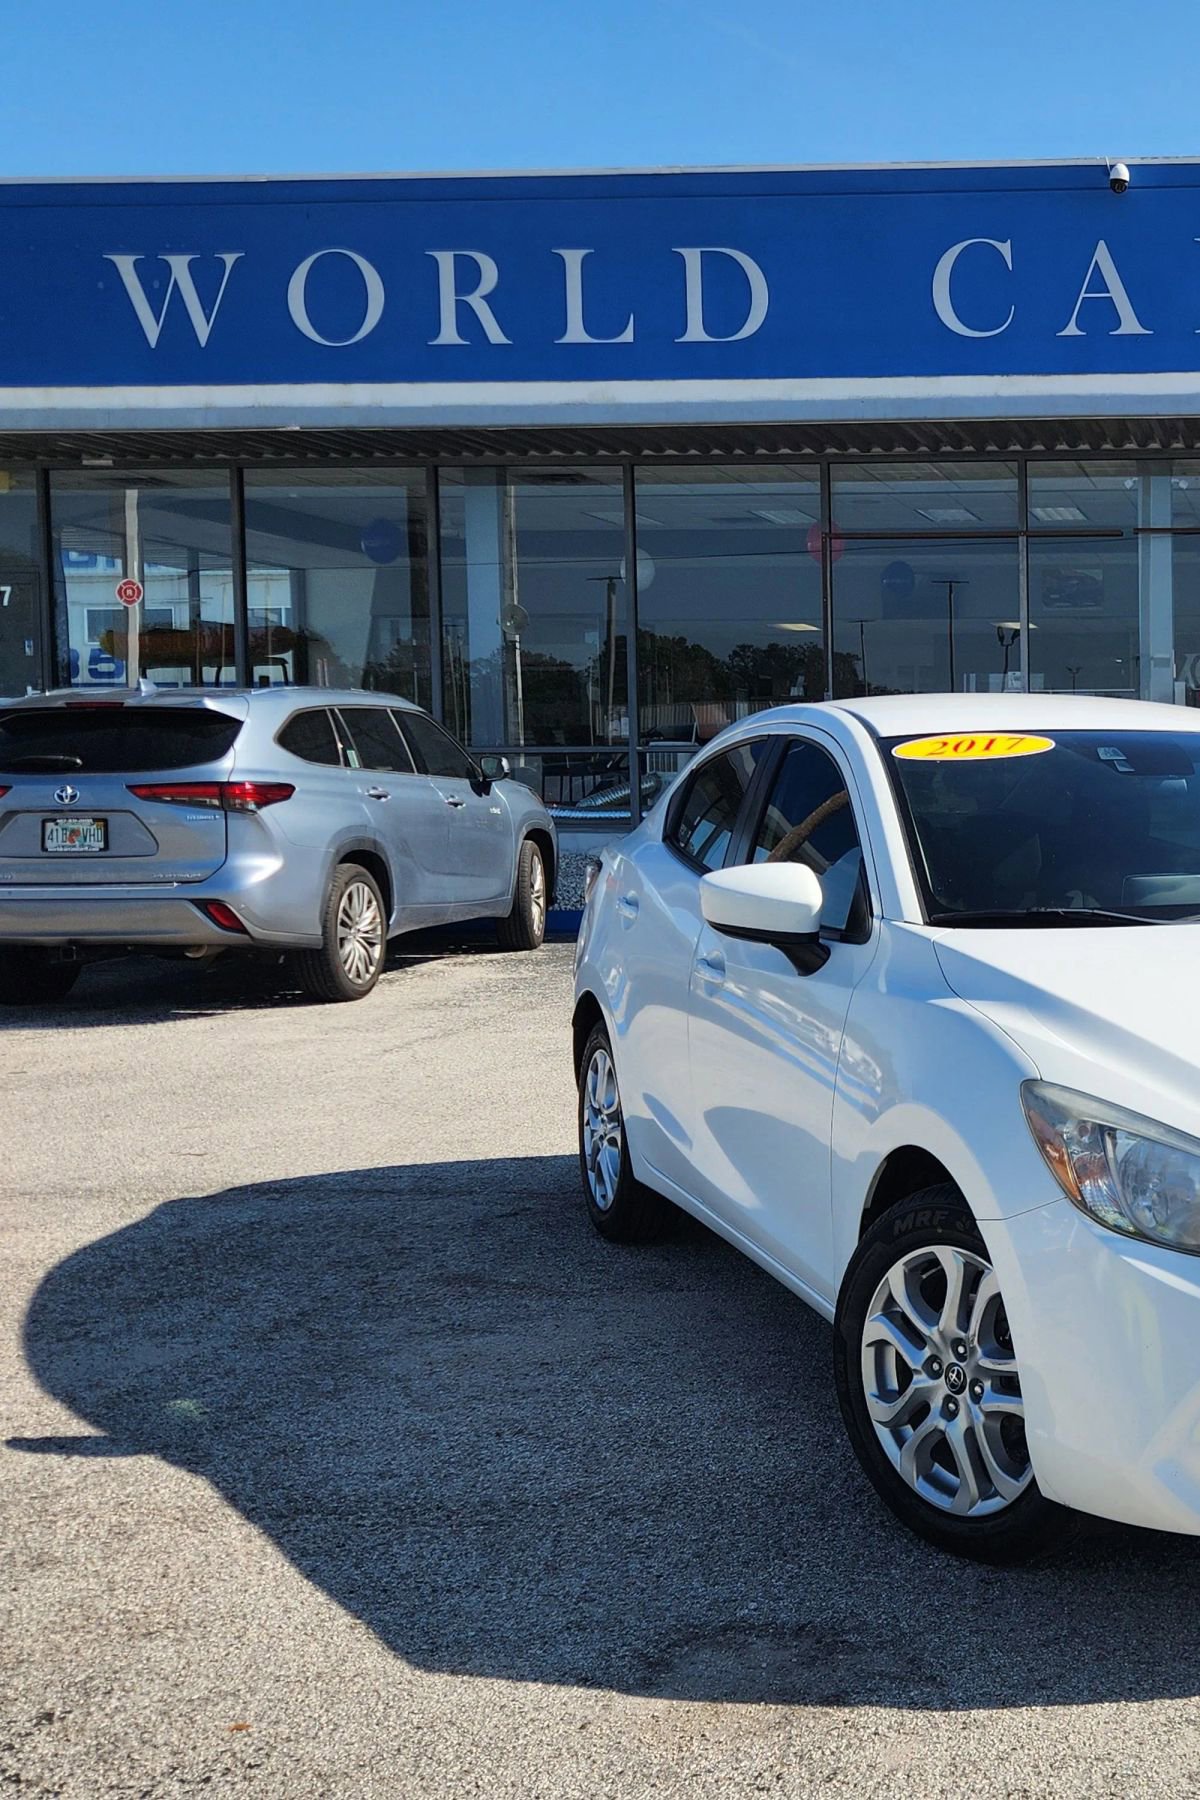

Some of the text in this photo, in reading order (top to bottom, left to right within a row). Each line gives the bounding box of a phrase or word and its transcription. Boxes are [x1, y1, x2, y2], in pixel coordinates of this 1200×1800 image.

[102, 247, 769, 350] WORLD
[926, 737, 1026, 756] 2017
[893, 1209, 950, 1237] MRF
